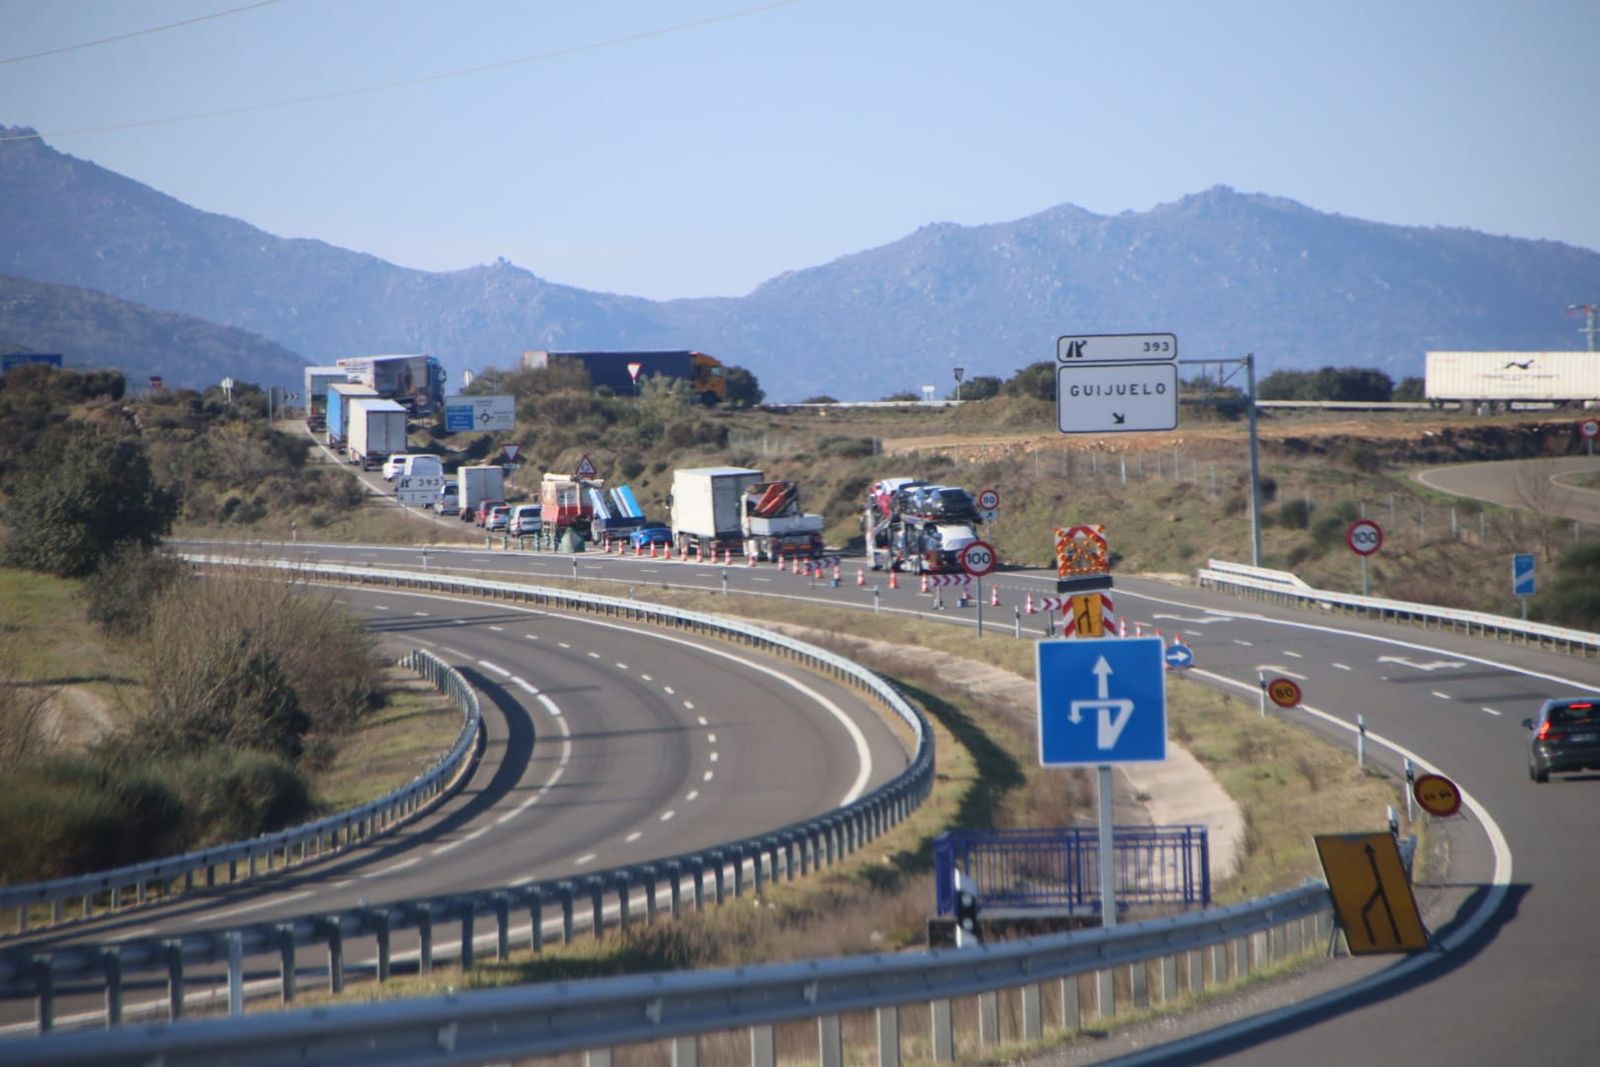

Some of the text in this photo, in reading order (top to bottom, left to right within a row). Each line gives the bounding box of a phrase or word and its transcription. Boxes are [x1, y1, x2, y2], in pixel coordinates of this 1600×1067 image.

[1143, 341, 1169, 352] 393
[1070, 382, 1166, 397] GUIJUELO
[418, 478, 440, 487] 393
[1353, 531, 1378, 545] 100
[967, 552, 991, 565] 100
